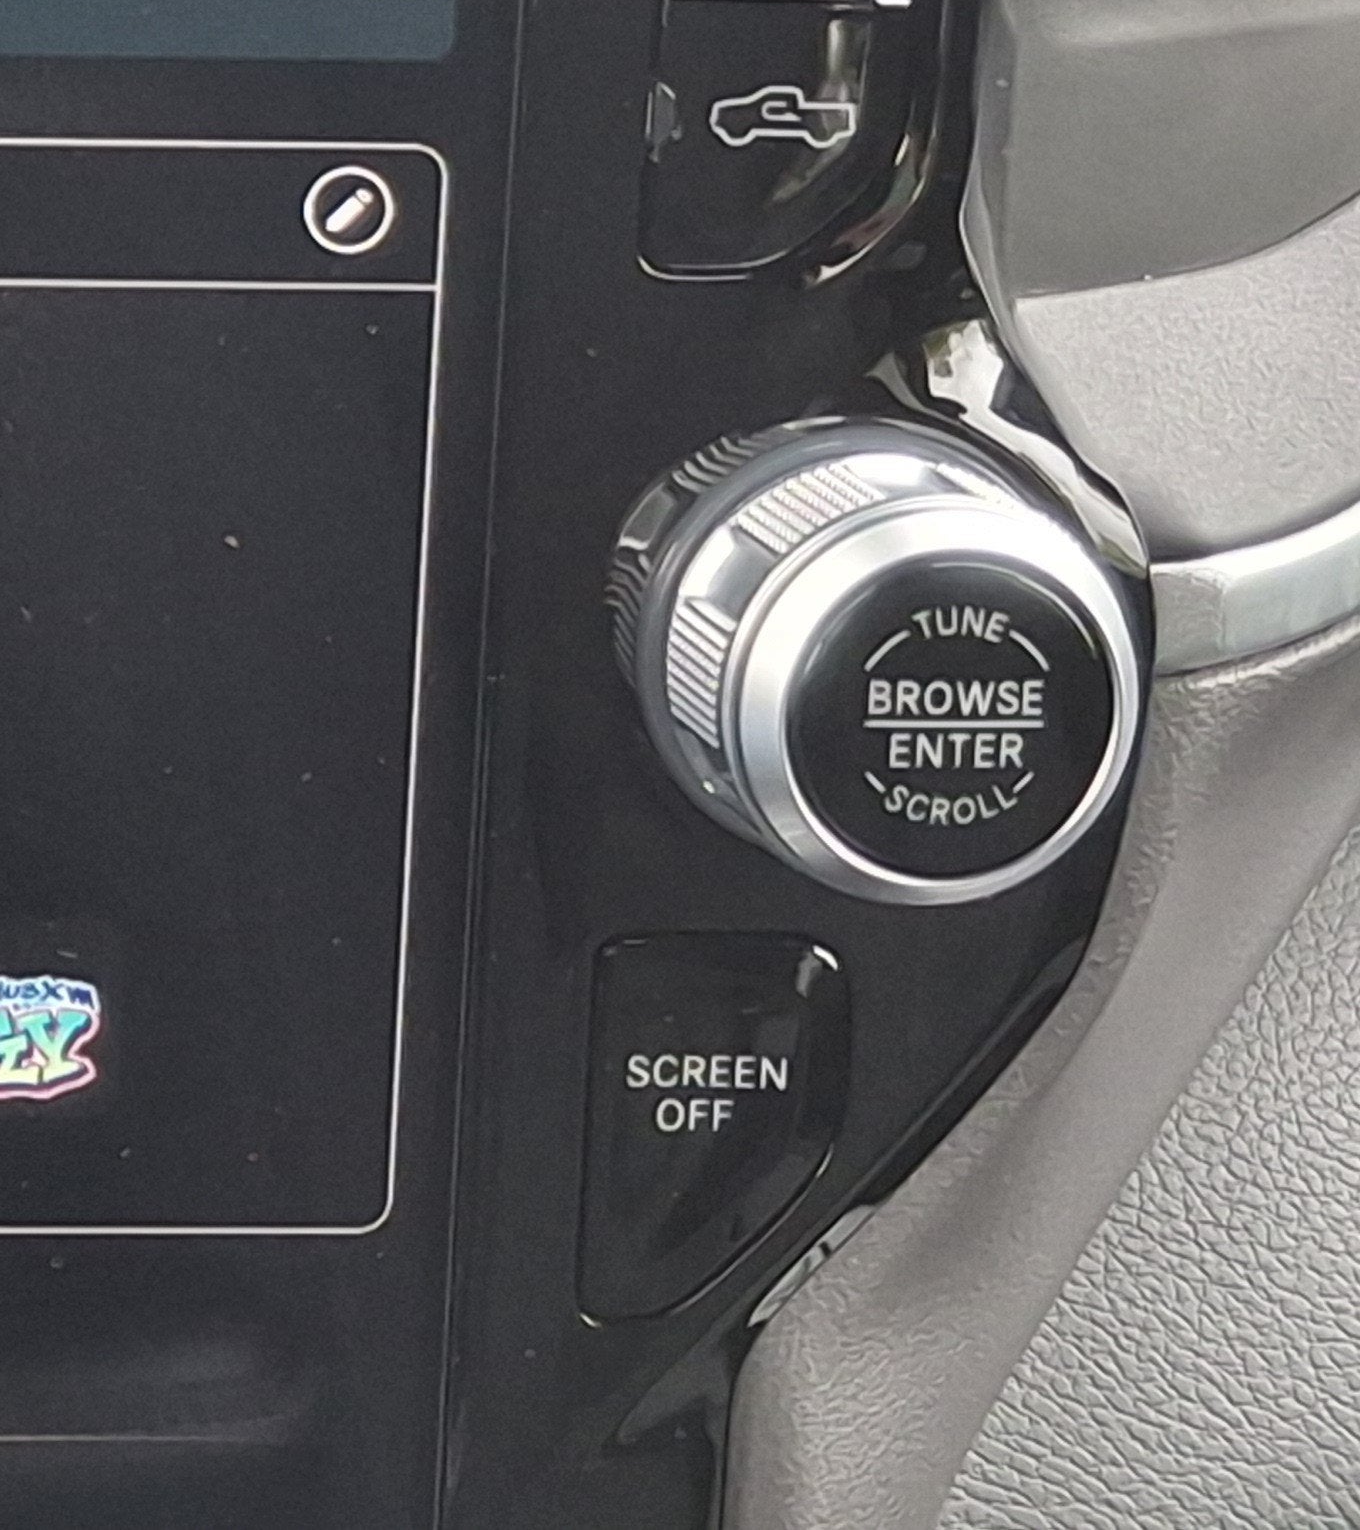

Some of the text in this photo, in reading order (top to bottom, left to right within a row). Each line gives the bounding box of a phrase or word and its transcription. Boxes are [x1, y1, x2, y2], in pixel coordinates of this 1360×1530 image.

[910, 605, 1011, 645] TUNE
[866, 678, 1046, 718] BROWSE
[888, 732, 1025, 771] ENTER
[884, 783, 1019, 826] SCROLL
[626, 1054, 788, 1092] SCREEN
[656, 1097, 735, 1133] OFF
